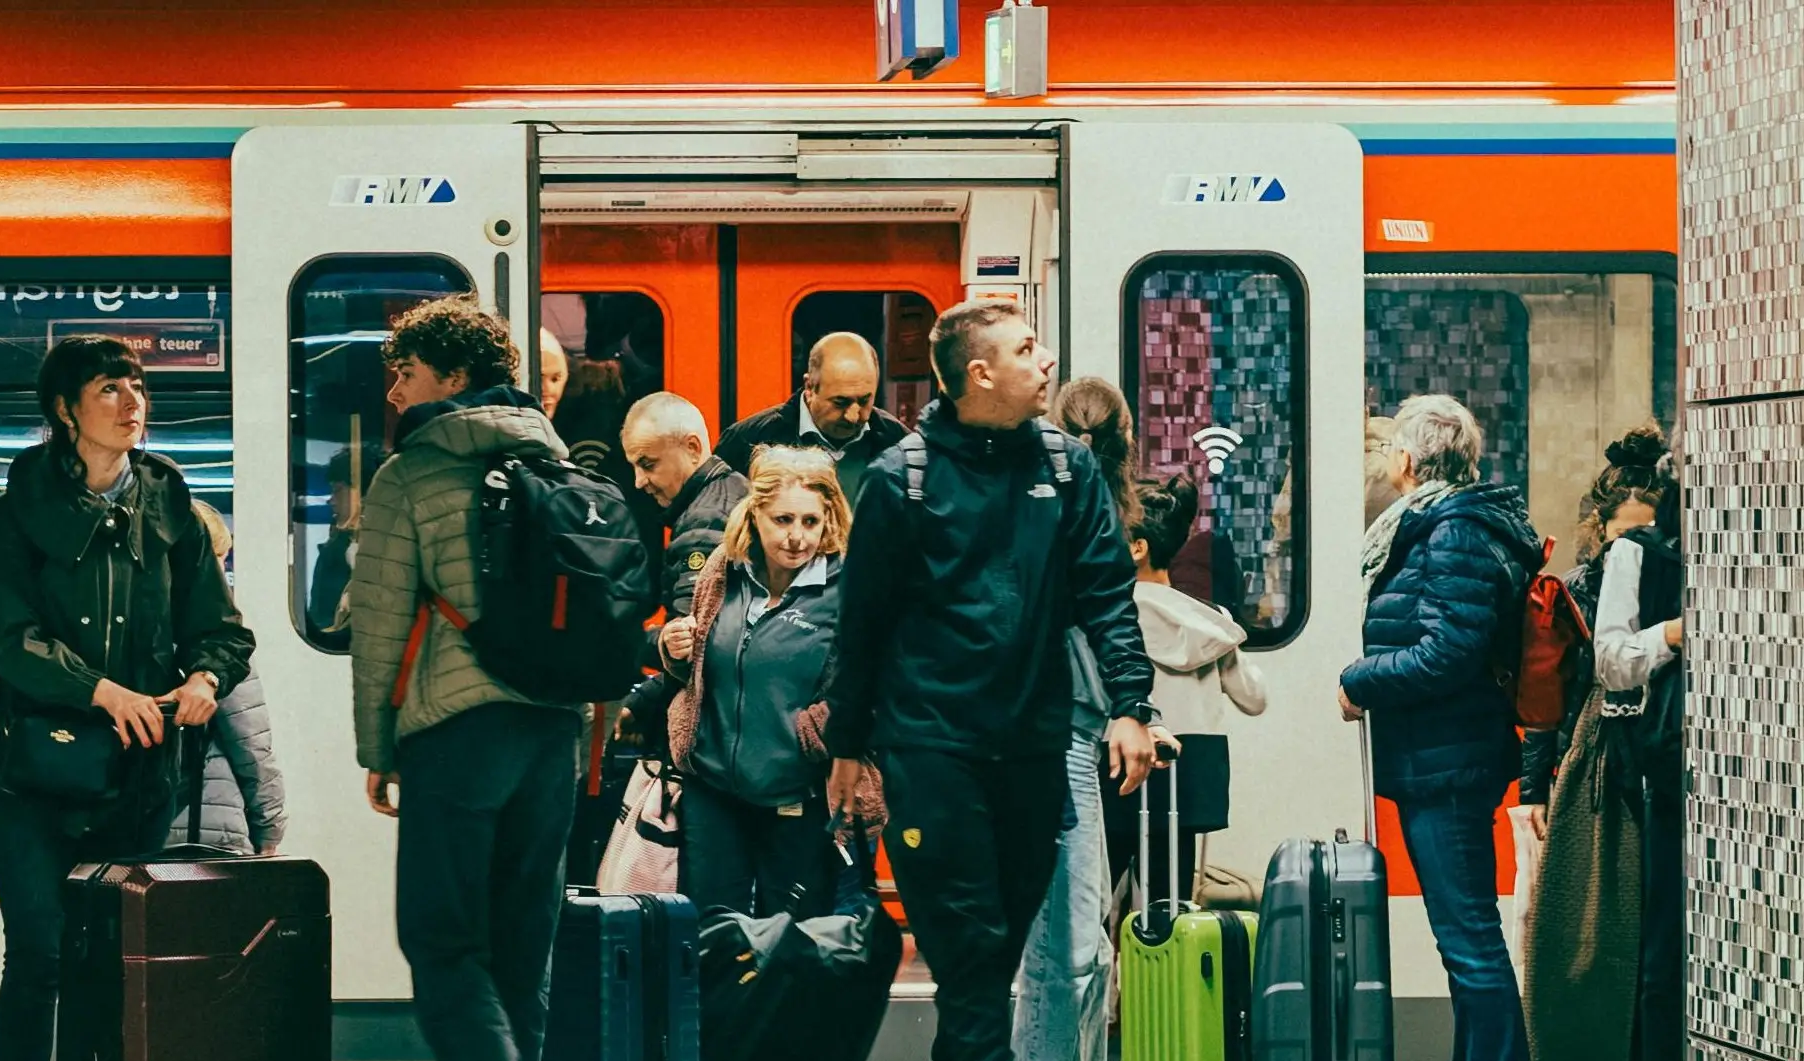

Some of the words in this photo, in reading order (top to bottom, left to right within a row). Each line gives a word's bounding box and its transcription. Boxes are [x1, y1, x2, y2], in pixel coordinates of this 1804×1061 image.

[353, 177, 445, 204] RMV
[1184, 175, 1276, 202] RMV
[122, 337, 152, 349] hne
[159, 338, 203, 351] teuer
